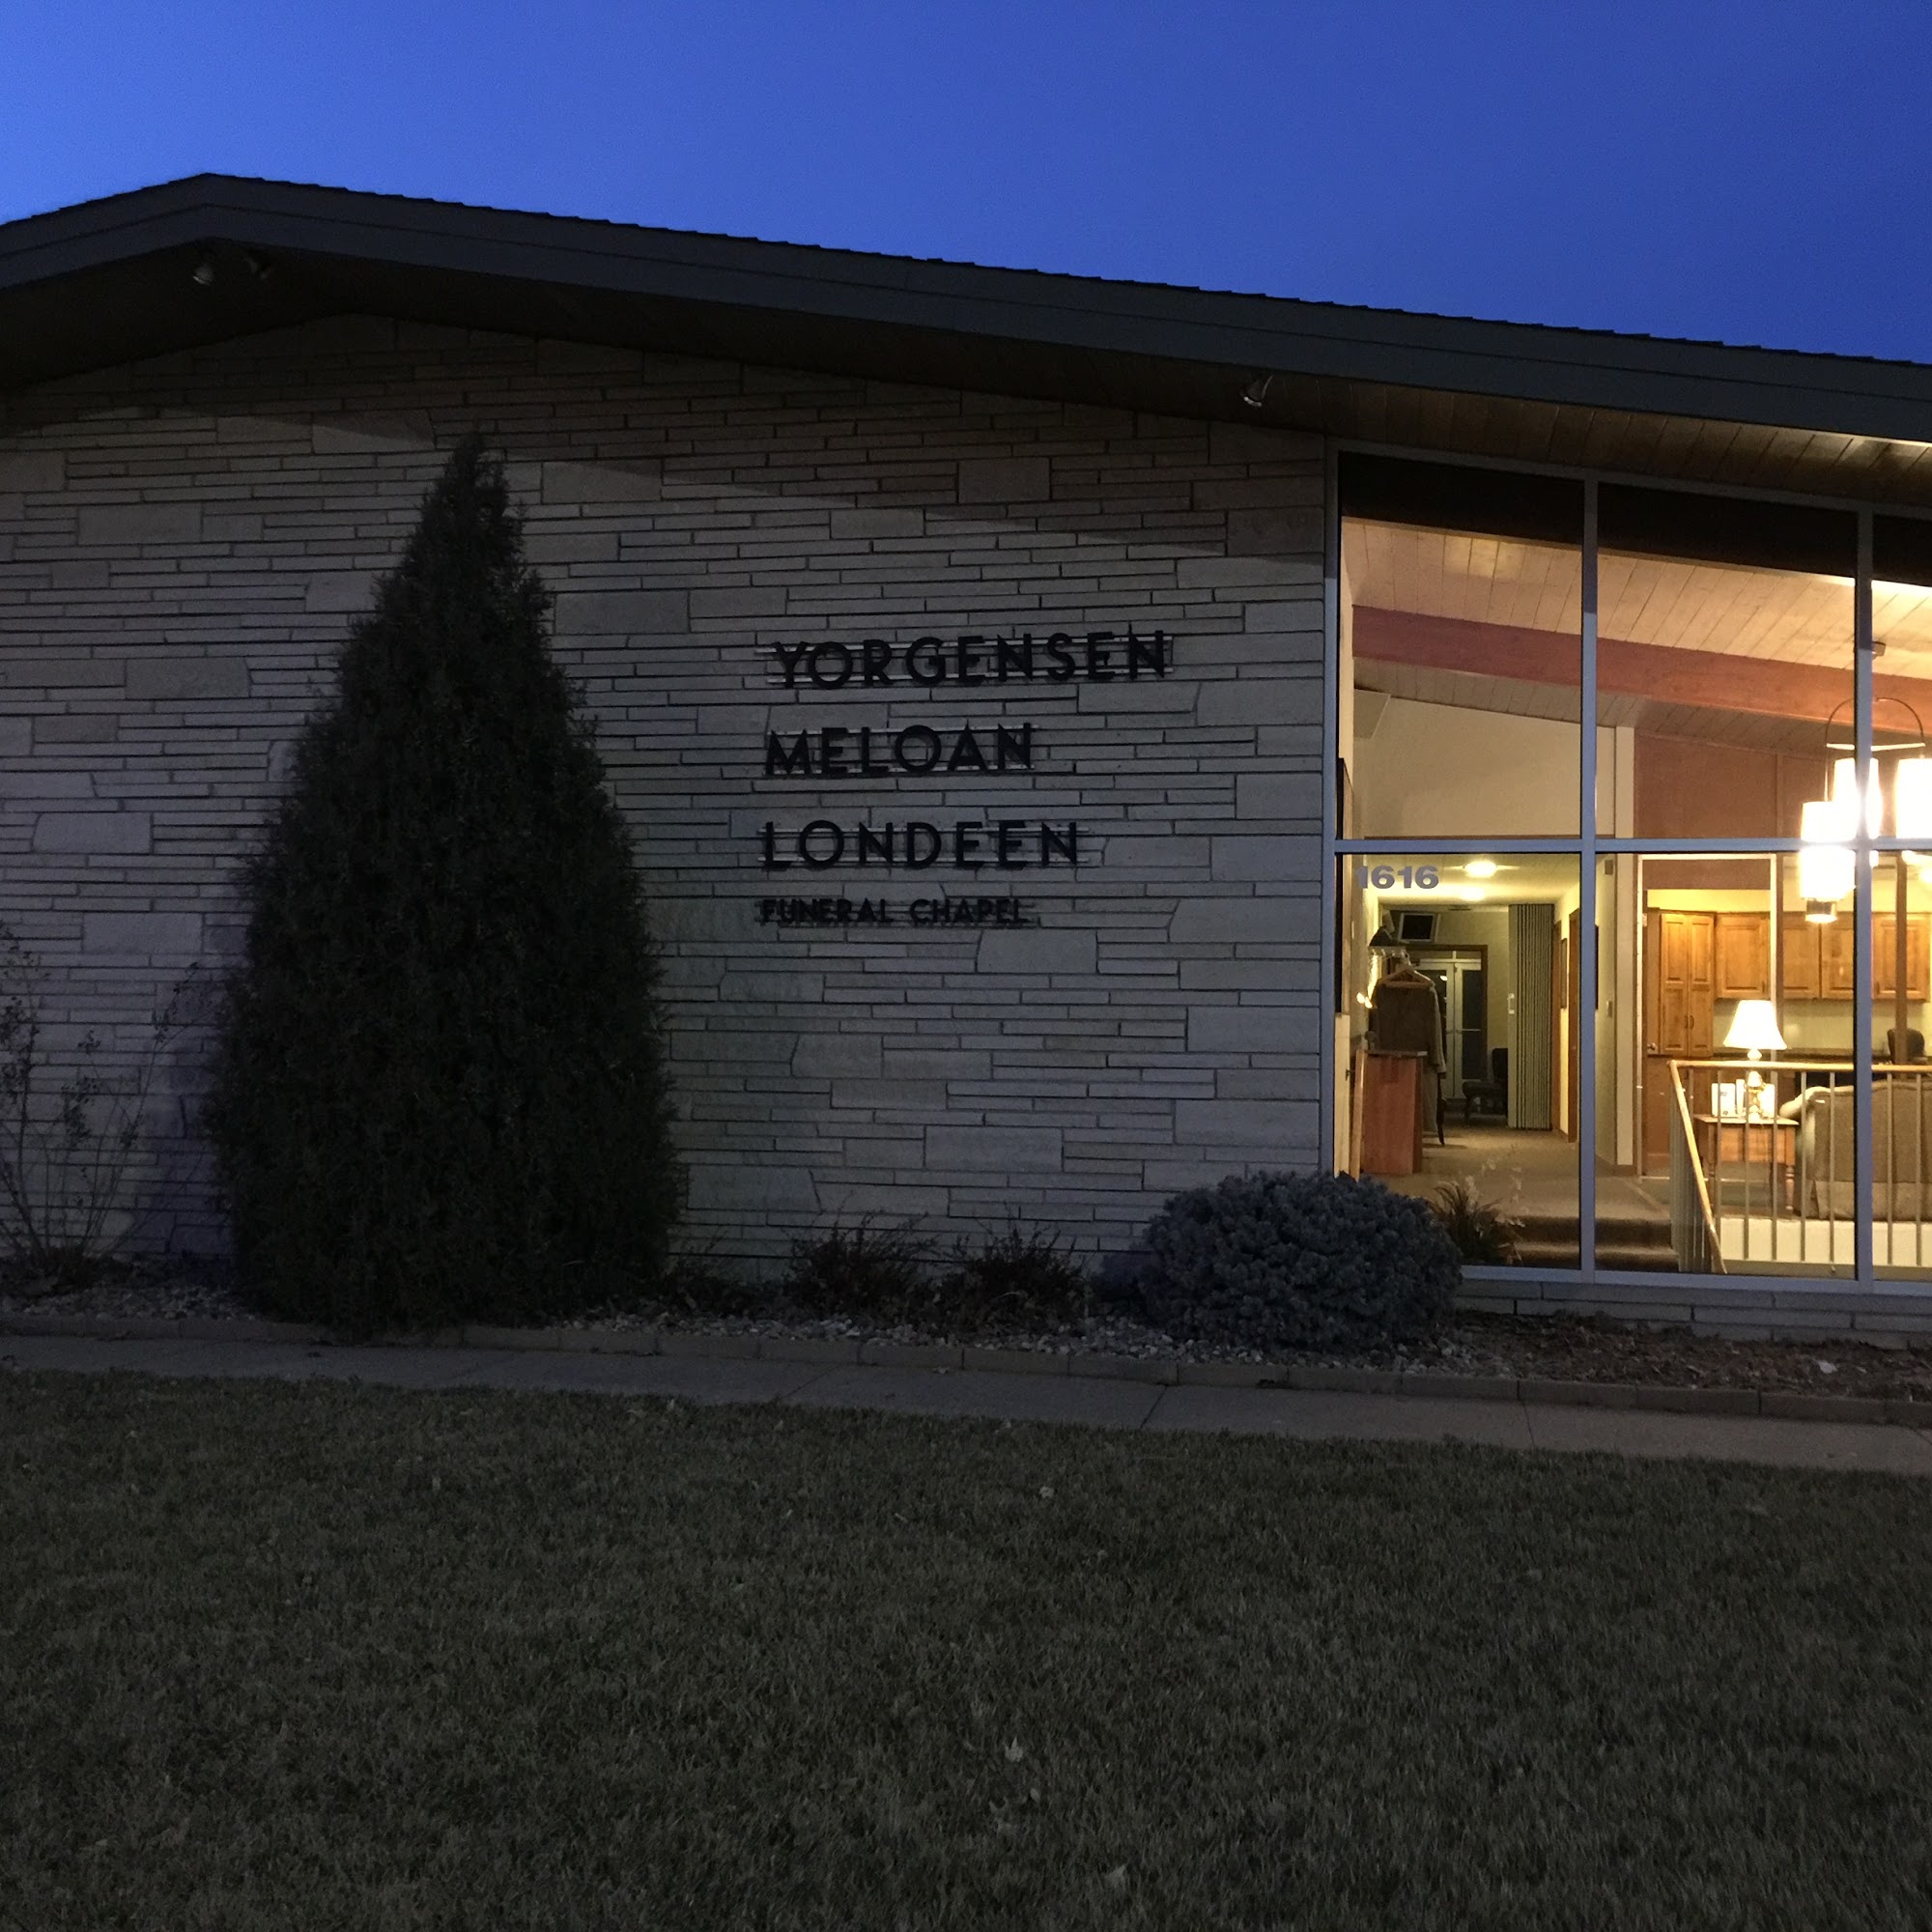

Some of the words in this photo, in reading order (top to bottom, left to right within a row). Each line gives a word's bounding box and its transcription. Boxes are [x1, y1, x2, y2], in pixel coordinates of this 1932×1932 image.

[773, 631, 1165, 688] YORGENSEN
[766, 723, 1032, 776] MELOAN
[764, 820, 1078, 869] LONDEEN
[1355, 866, 1439, 889] 1616
[761, 897, 895, 924] FUNERAL
[910, 896, 1028, 923] CHAPEL
